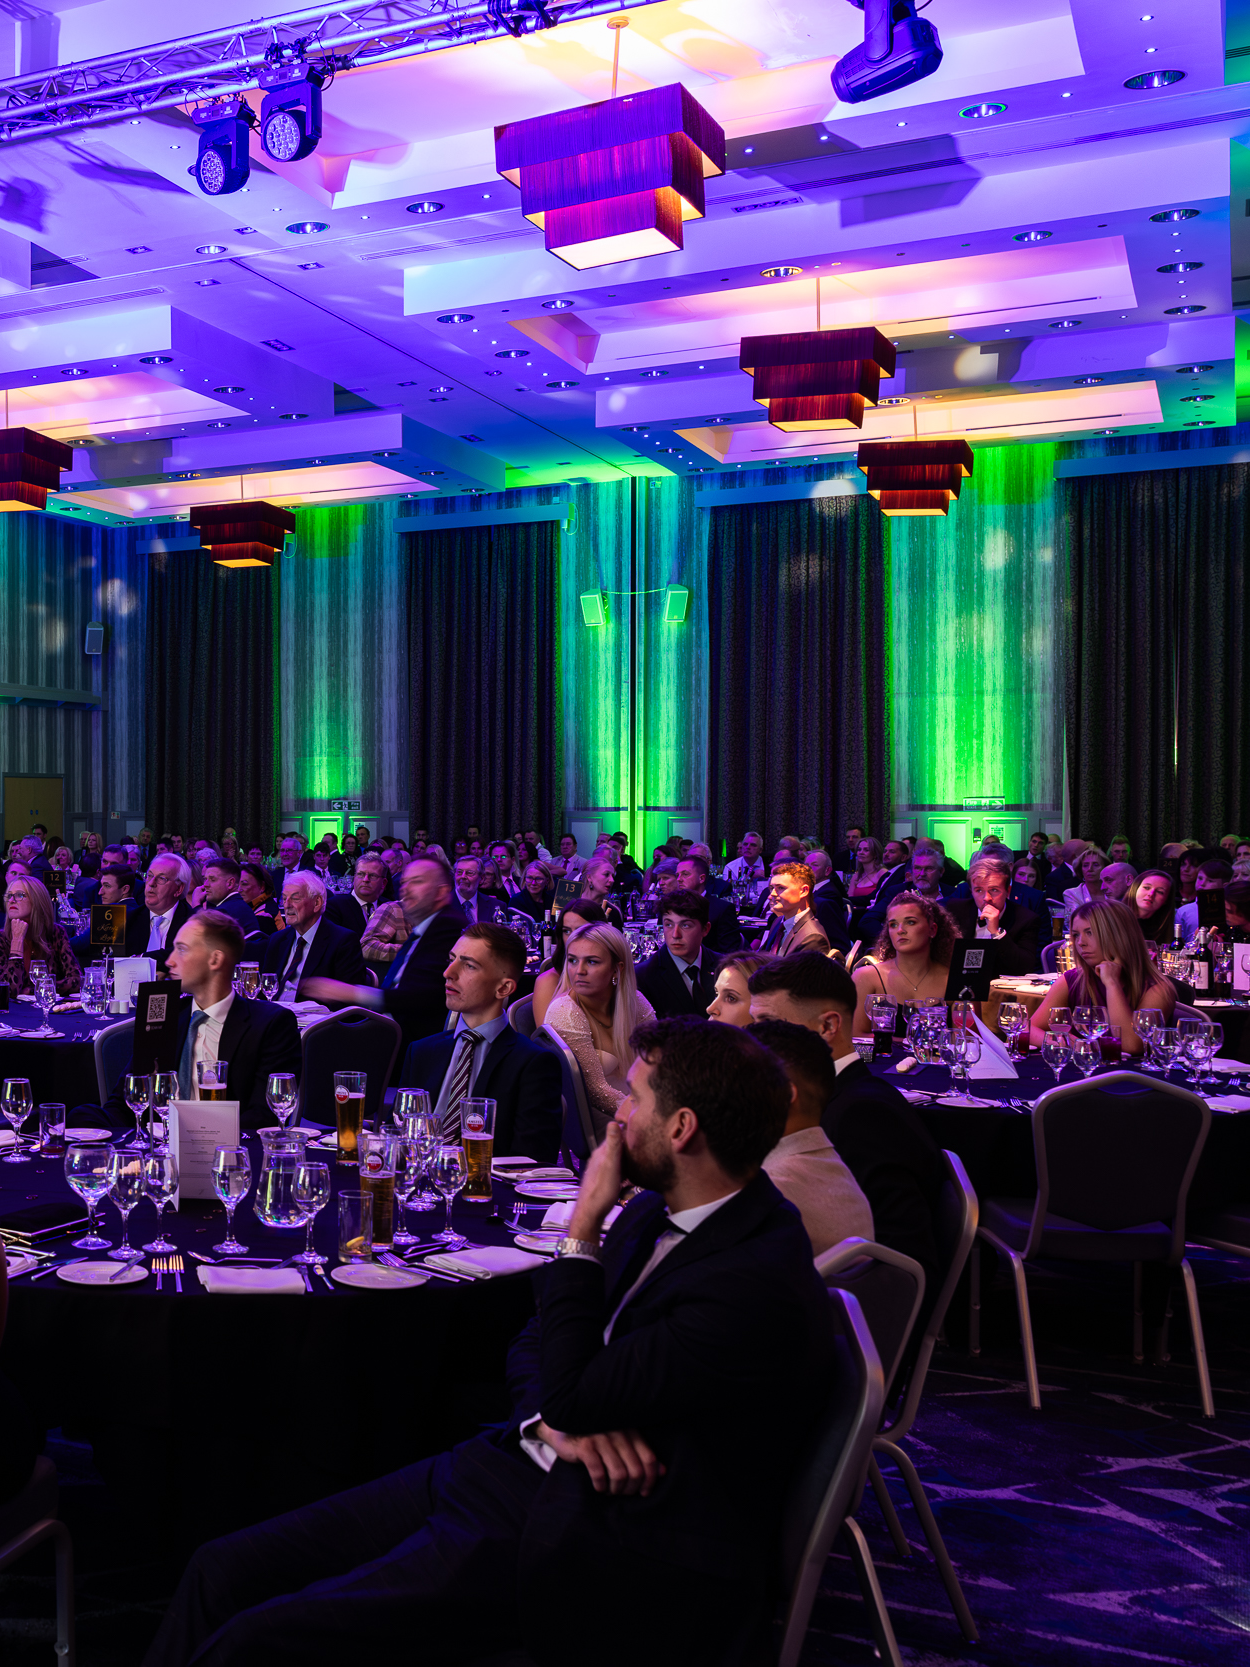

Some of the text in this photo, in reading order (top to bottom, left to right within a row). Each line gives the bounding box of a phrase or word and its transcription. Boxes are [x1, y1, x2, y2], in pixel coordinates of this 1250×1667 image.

[50, 873, 60, 881] 12
[565, 883, 576, 893] 13
[1206, 893, 1217, 904] 14
[104, 909, 113, 921] 6
